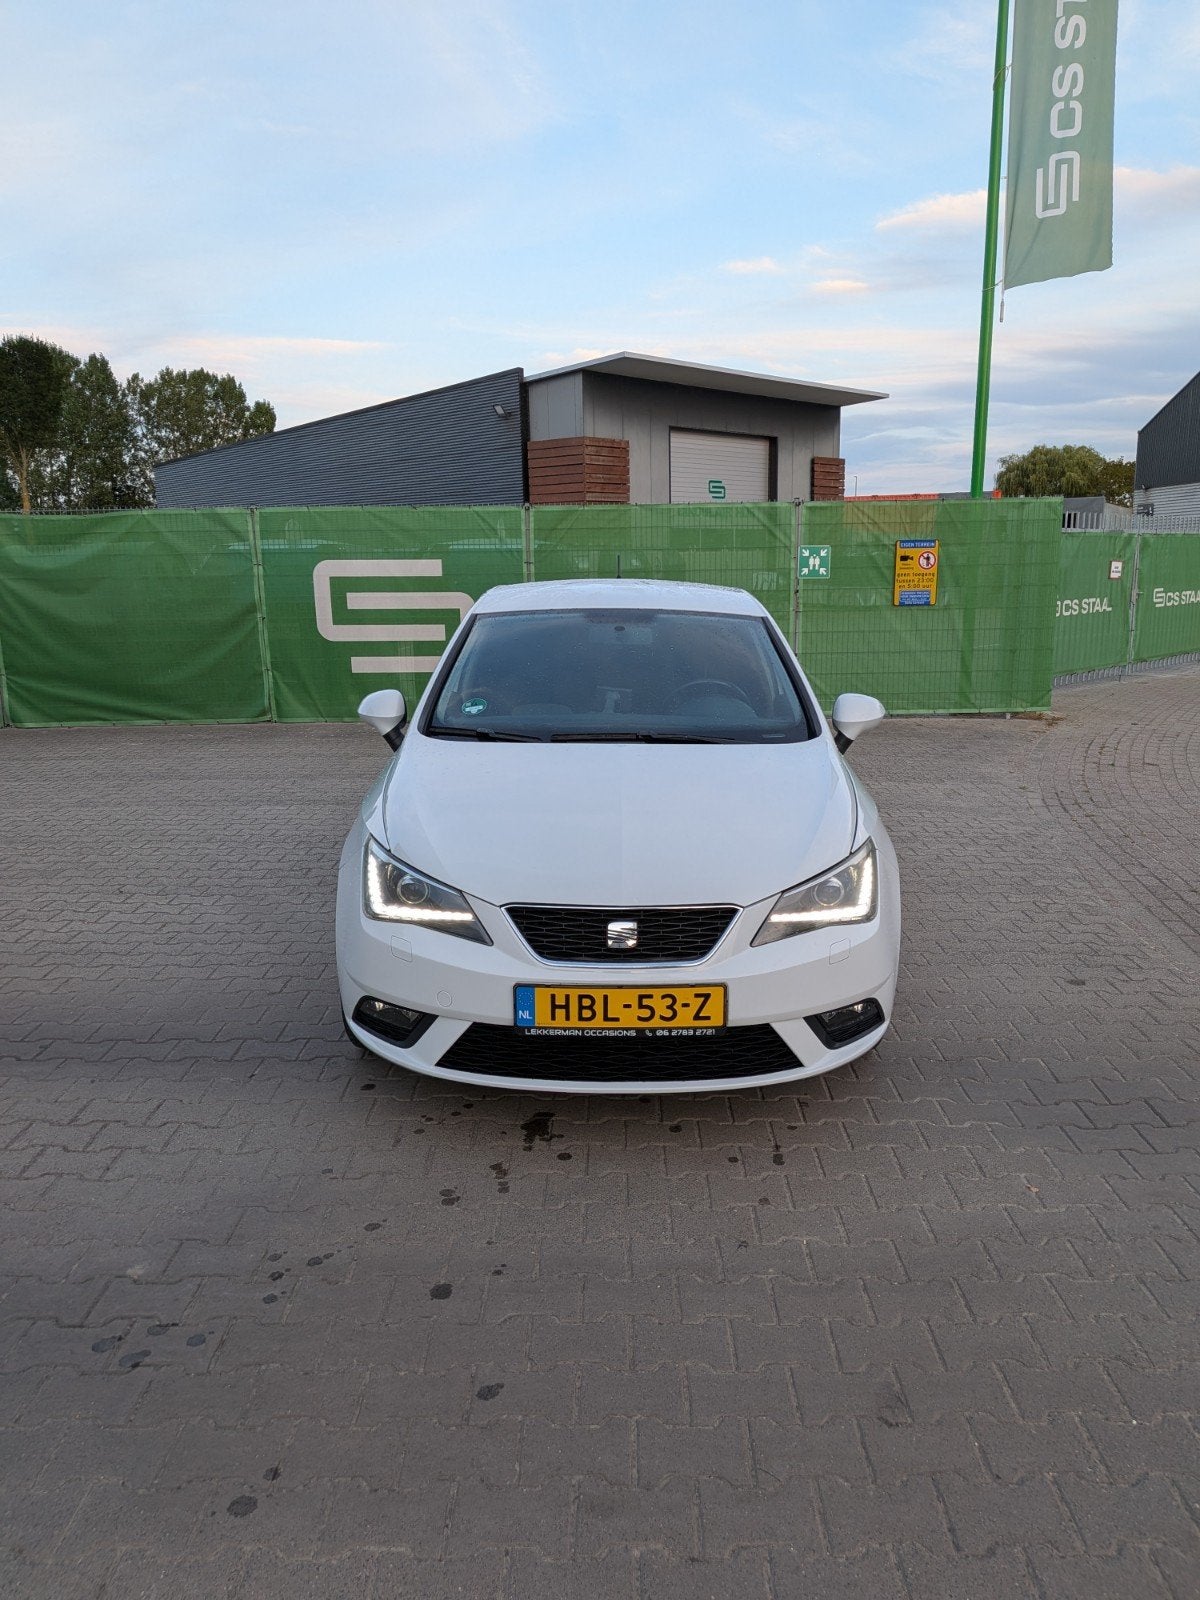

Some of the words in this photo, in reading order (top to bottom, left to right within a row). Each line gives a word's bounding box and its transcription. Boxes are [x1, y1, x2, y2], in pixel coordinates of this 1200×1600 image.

[1050, 62, 1084, 139] CS
[1166, 591, 1180, 607] CS
[1062, 599, 1079, 616] CS
[518, 1010, 533, 1020] NL
[549, 992, 712, 1023] HBL-53-Z
[525, 1028, 583, 1037] LEKKERMAN
[584, 1029, 637, 1037] OCCASIONS
[695, 1028, 716, 1036] 2721
